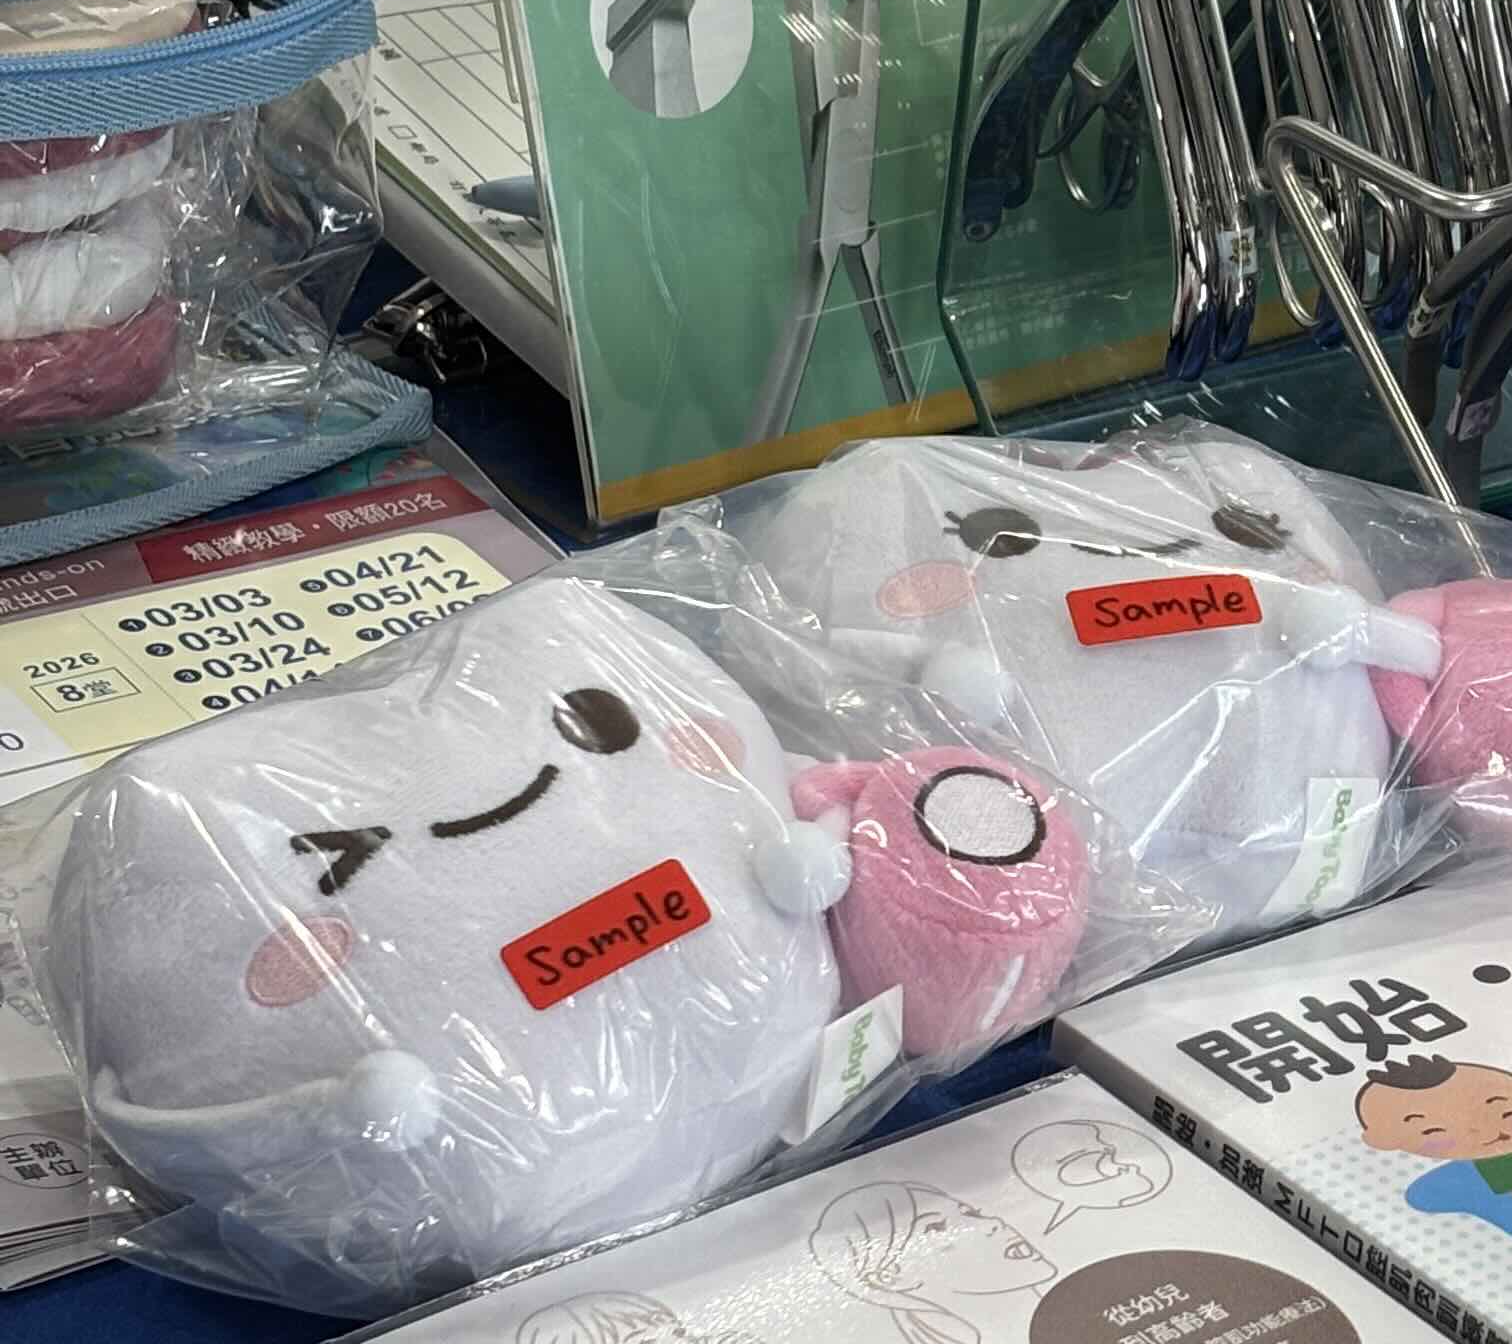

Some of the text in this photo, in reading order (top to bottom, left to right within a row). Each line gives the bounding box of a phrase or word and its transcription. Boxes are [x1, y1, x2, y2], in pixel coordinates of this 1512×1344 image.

[1094, 584, 1244, 628] Sample
[178, 612, 305, 652] 03/10
[22, 652, 100, 679] 2026
[203, 637, 331, 679] 03/24
[524, 885, 692, 989] Sample
[1103, 1283, 1190, 1328] 從幼兒
